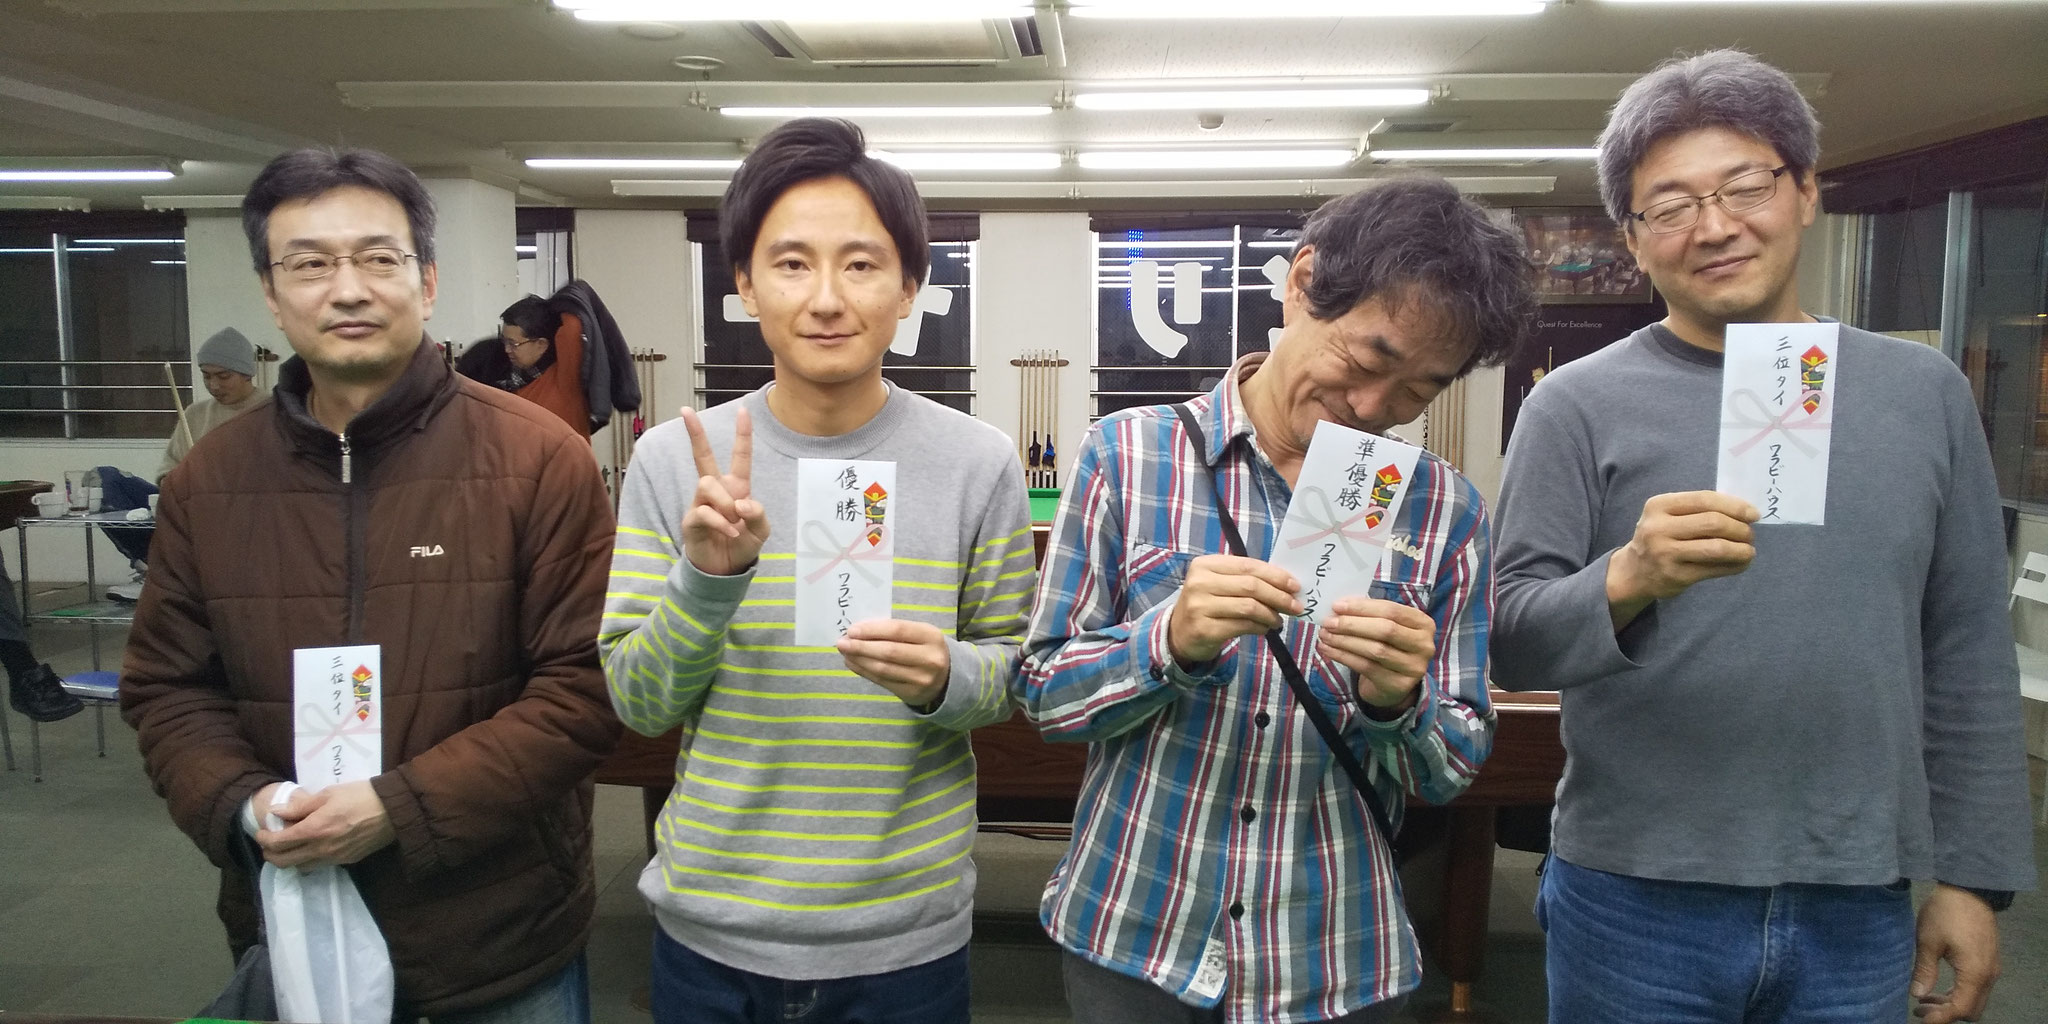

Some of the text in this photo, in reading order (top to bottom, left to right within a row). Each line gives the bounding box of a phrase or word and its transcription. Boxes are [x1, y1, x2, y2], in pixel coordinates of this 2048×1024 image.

[1536, 320, 1603, 329] Quest For Excellence
[1773, 336, 1793, 406] 三位タイ
[834, 465, 862, 522] 優勝
[1334, 438, 1376, 511] 準優勝
[410, 544, 445, 558] FILA
[330, 655, 345, 715] 三位タイ
